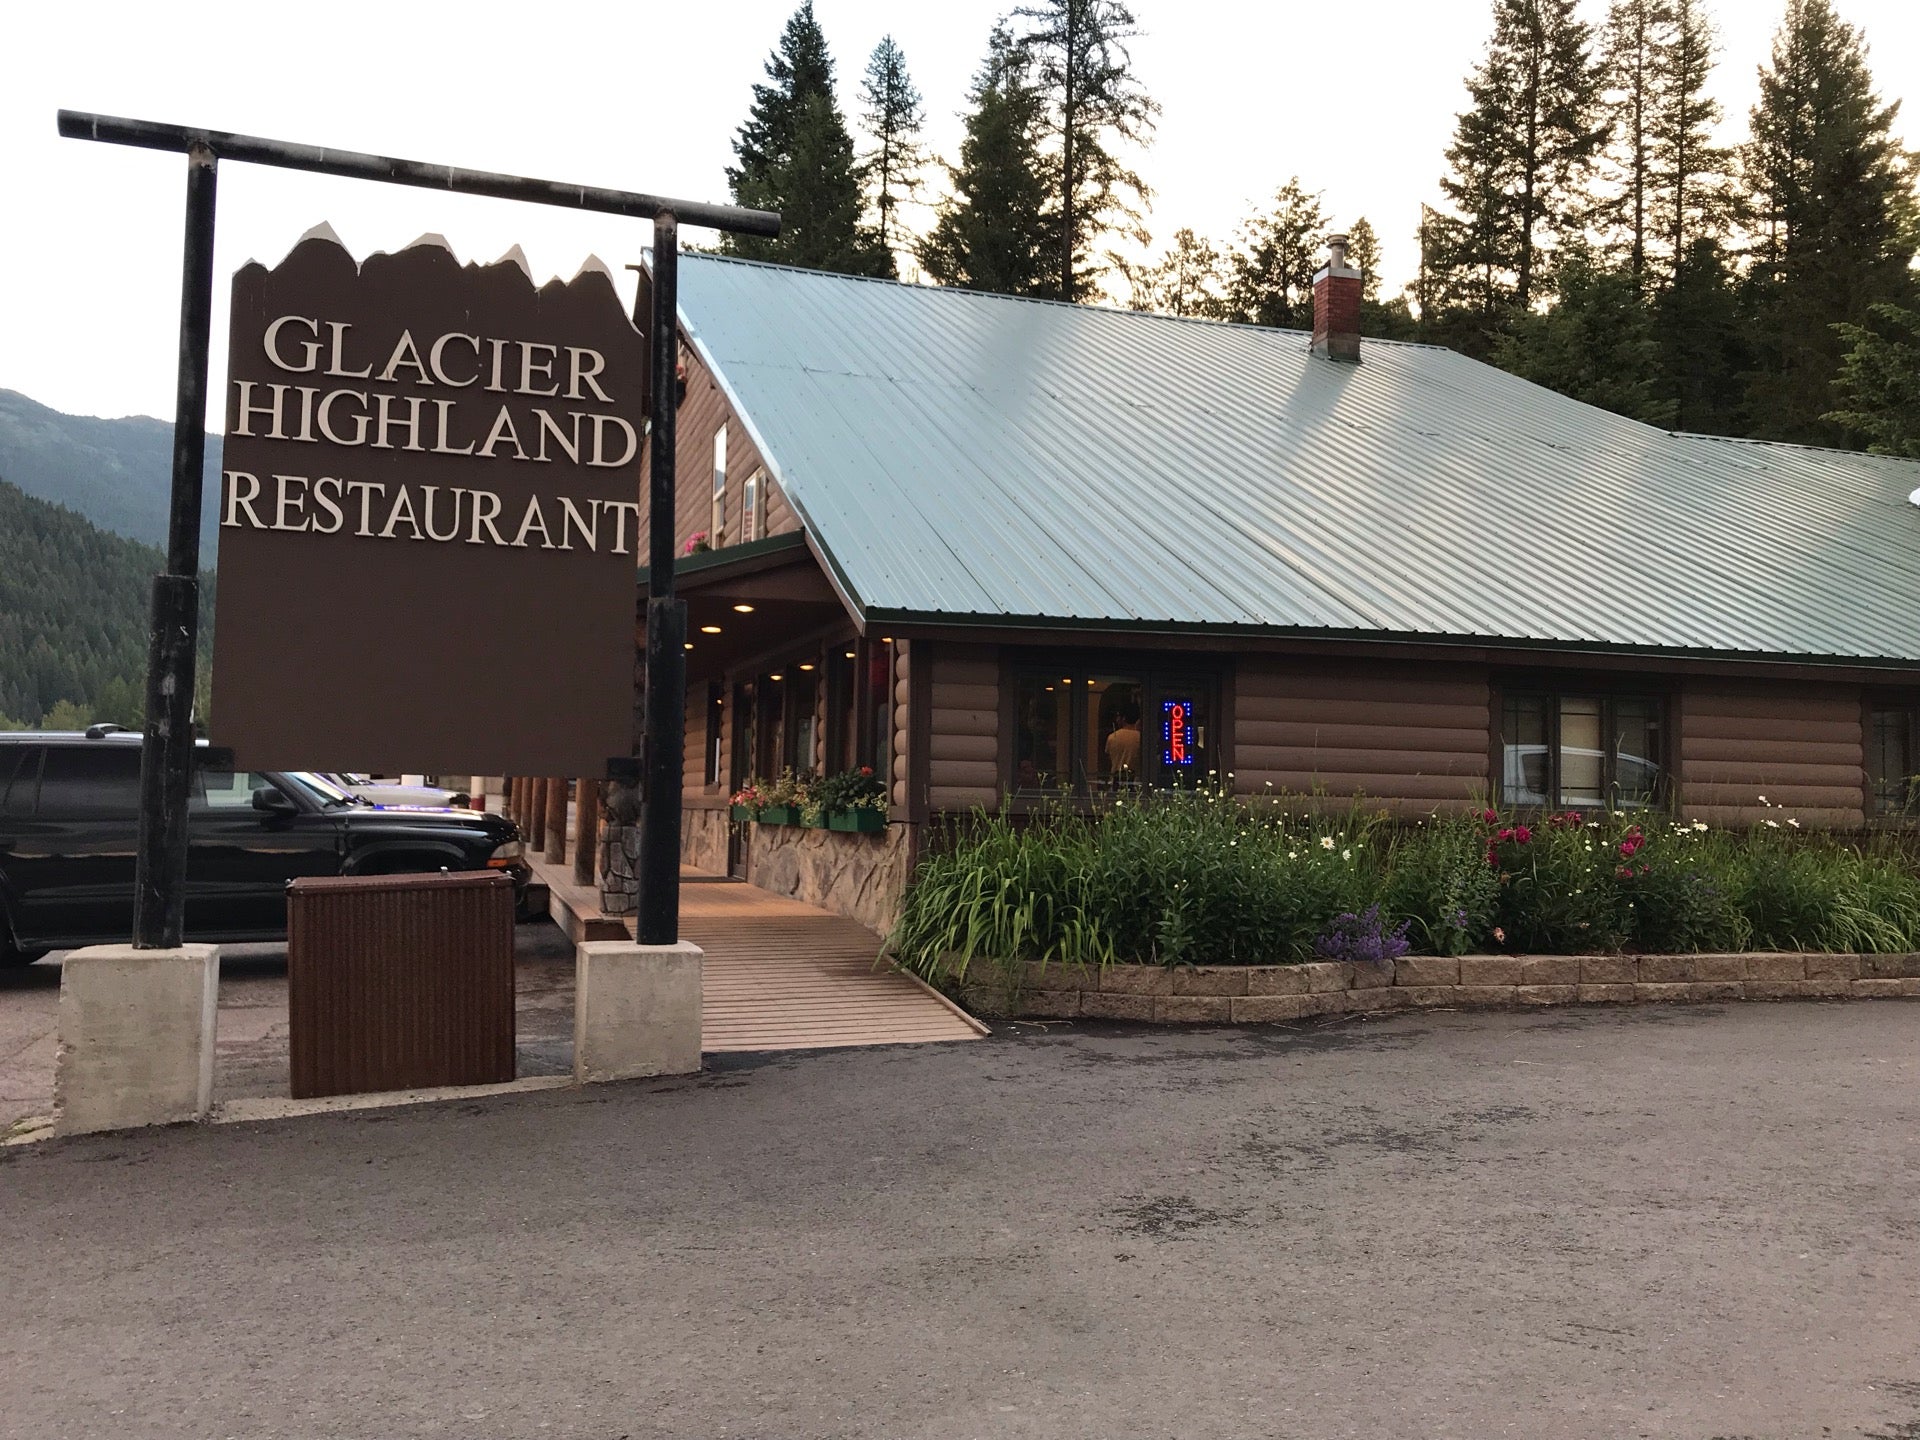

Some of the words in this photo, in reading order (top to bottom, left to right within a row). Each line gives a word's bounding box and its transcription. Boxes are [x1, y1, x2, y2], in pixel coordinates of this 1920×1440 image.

[264, 316, 614, 402] GLACIER
[231, 380, 637, 468] HIGHLAND
[221, 471, 639, 554] RESTAURANT
[1171, 704, 1185, 762] OPEN
